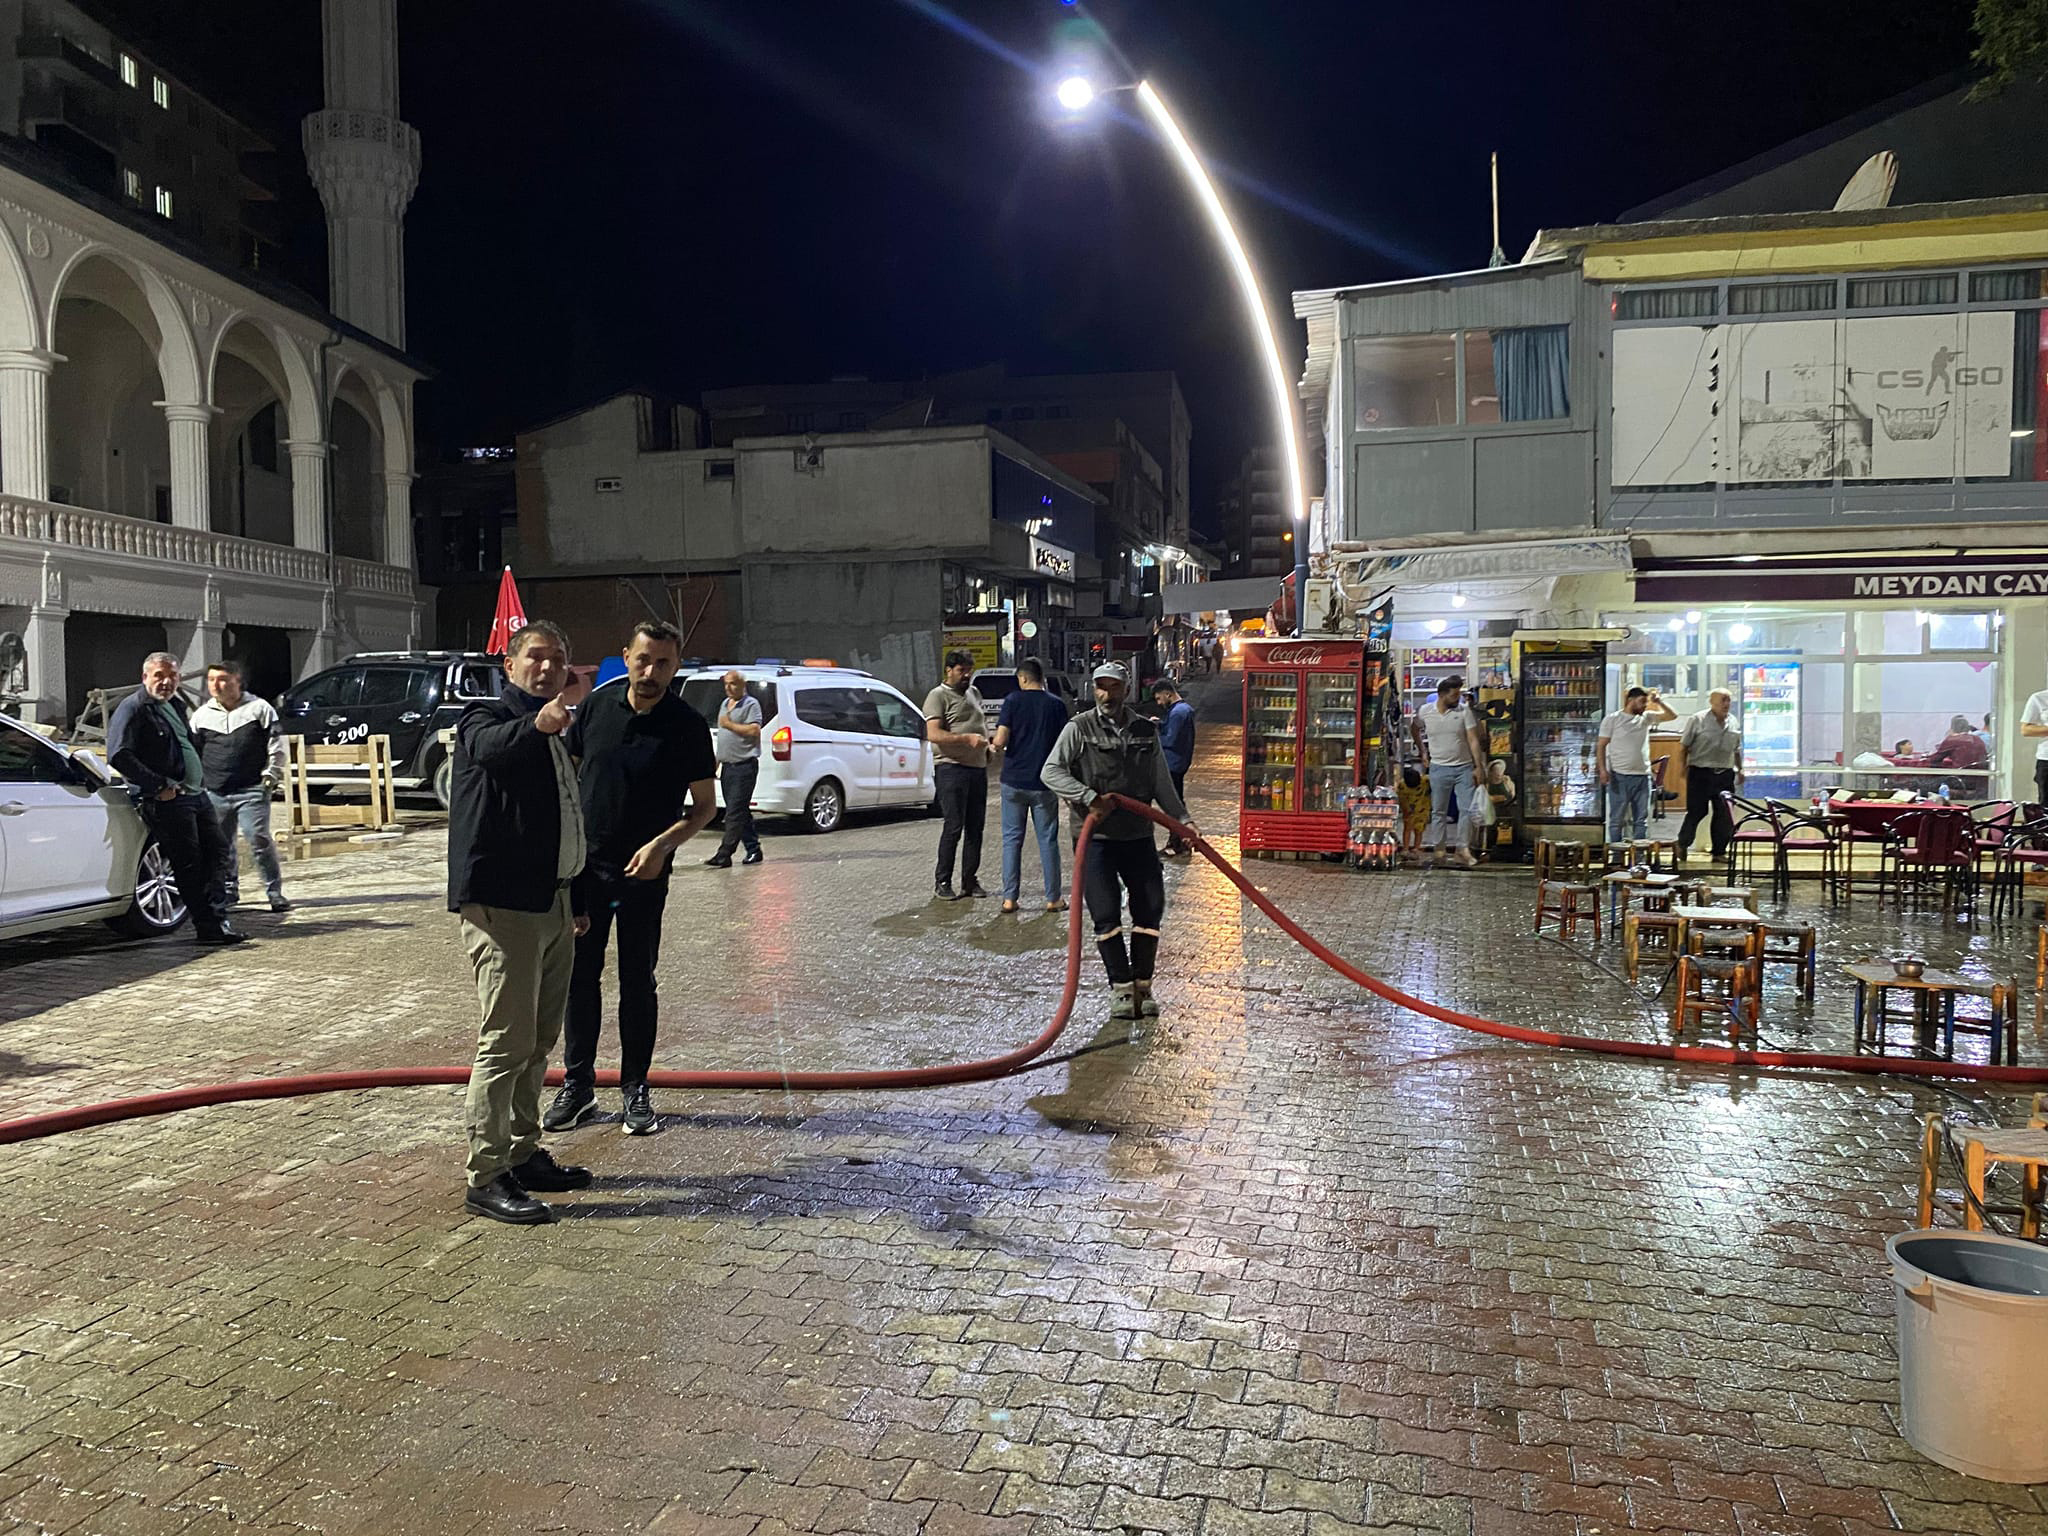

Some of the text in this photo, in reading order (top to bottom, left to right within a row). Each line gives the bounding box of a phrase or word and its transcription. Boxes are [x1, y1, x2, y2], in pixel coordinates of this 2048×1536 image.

[1877, 367, 2003, 388] CS GO
[1854, 575, 1986, 595] MEYDAN
[337, 723, 368, 745] 200
